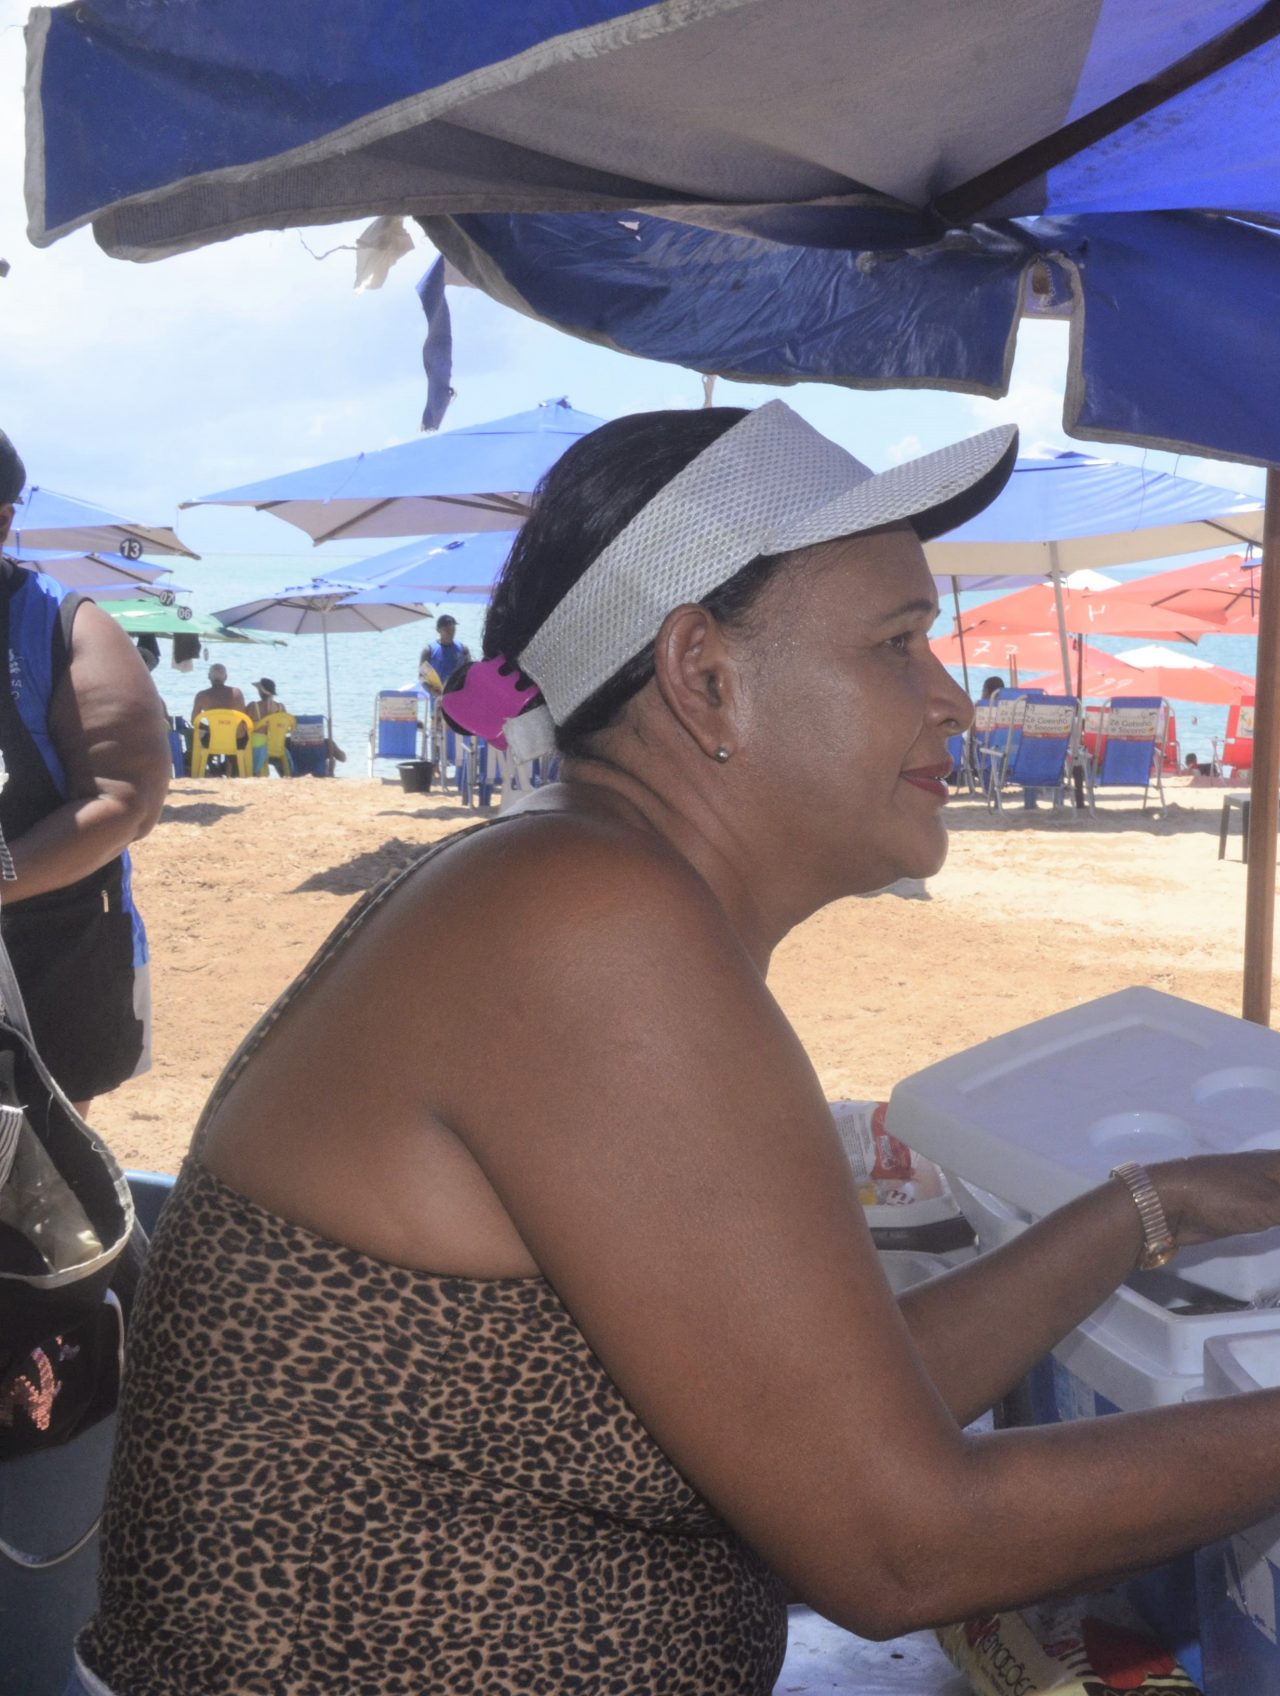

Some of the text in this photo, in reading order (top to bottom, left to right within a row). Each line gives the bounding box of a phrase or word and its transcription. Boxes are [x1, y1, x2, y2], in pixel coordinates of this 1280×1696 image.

[122, 540, 140, 558] 13
[160, 591, 174, 604] 07
[179, 608, 191, 619] 06
